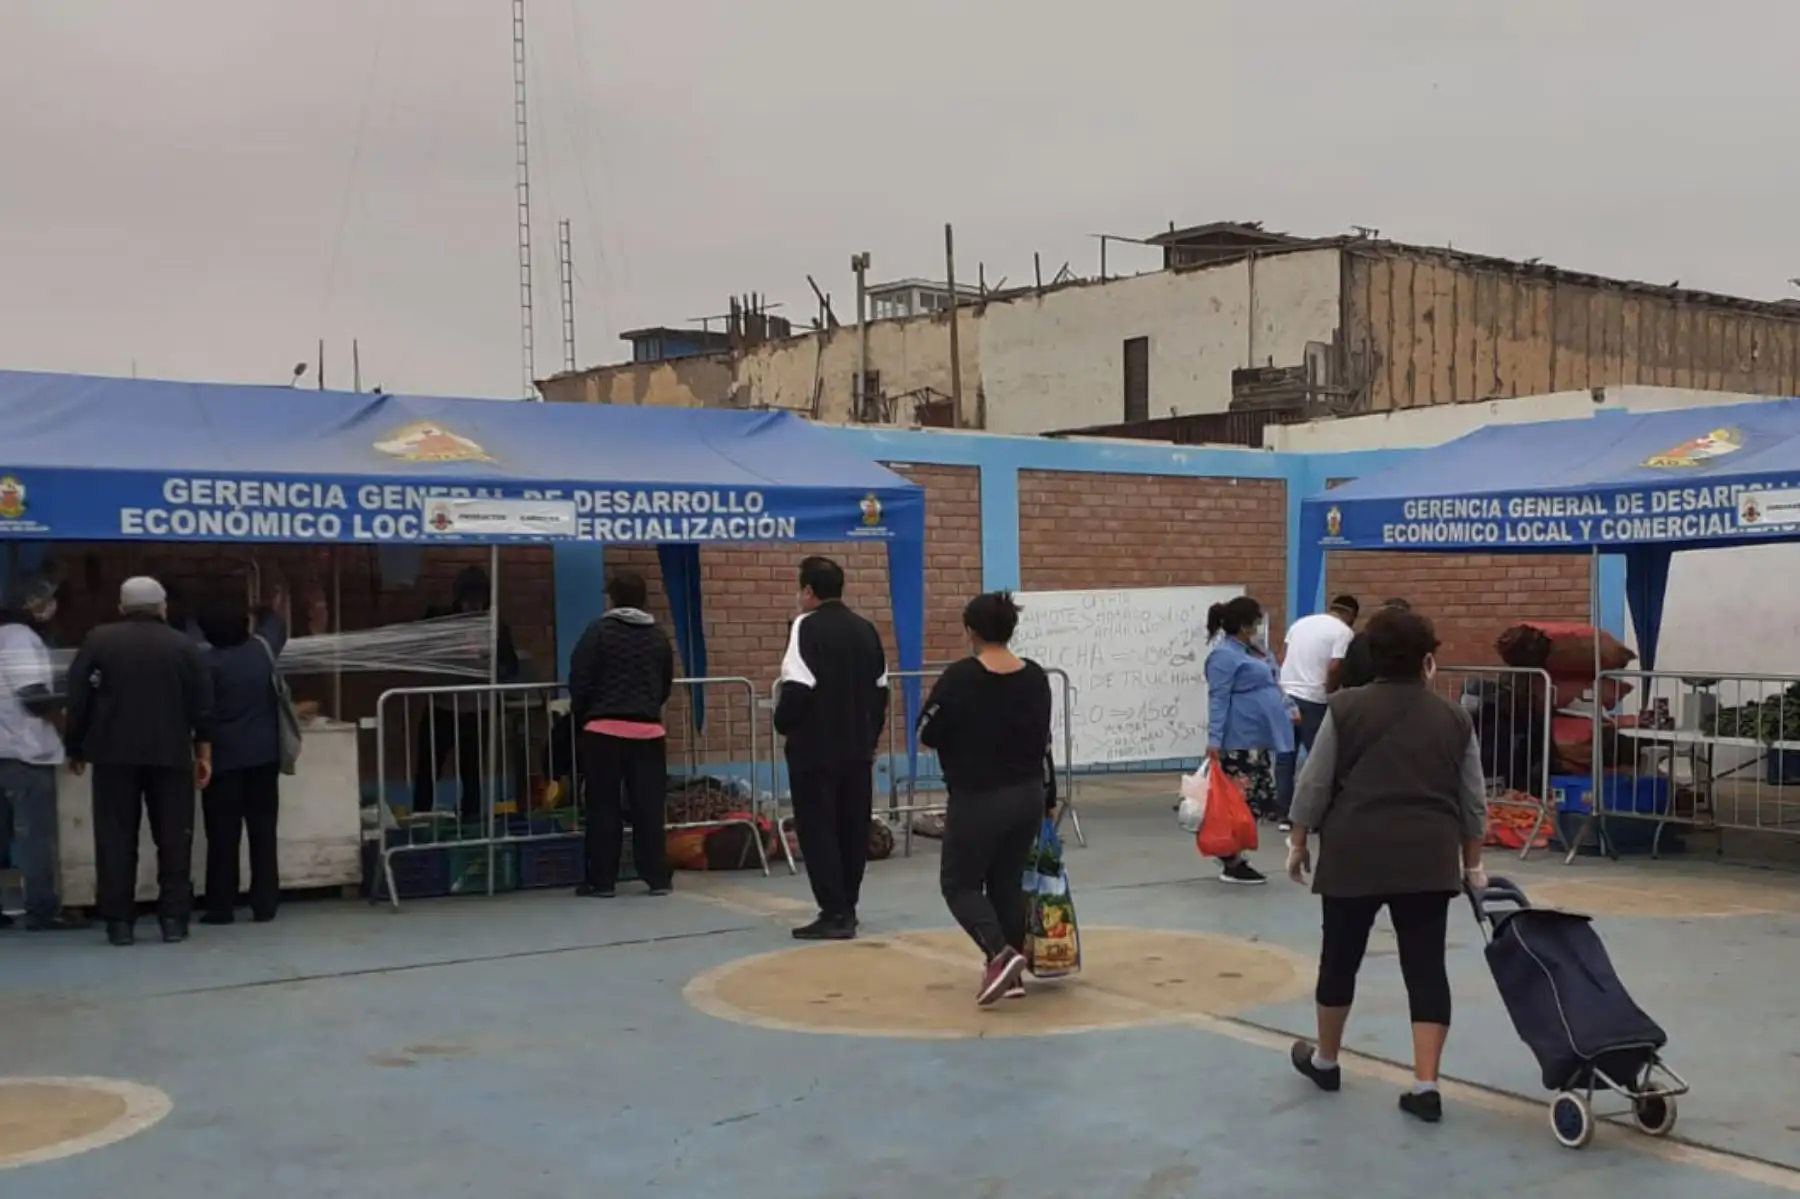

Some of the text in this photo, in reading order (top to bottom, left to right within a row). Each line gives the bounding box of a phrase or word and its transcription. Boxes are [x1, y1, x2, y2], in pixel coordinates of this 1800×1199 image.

[163, 478, 347, 509] GERENCIA
[573, 490, 763, 514] DESARROLLO
[1404, 498, 1501, 519] GERENCIA
[1508, 494, 1607, 518] GENERAL
[1615, 493, 1645, 514] DE
[1652, 482, 1800, 513] DESARR
[121, 505, 340, 538] ECONÓMICO
[1382, 517, 1498, 544] ECONÓMICO
[1505, 520, 1572, 542] LOCAL
[1580, 520, 1593, 541] Y
